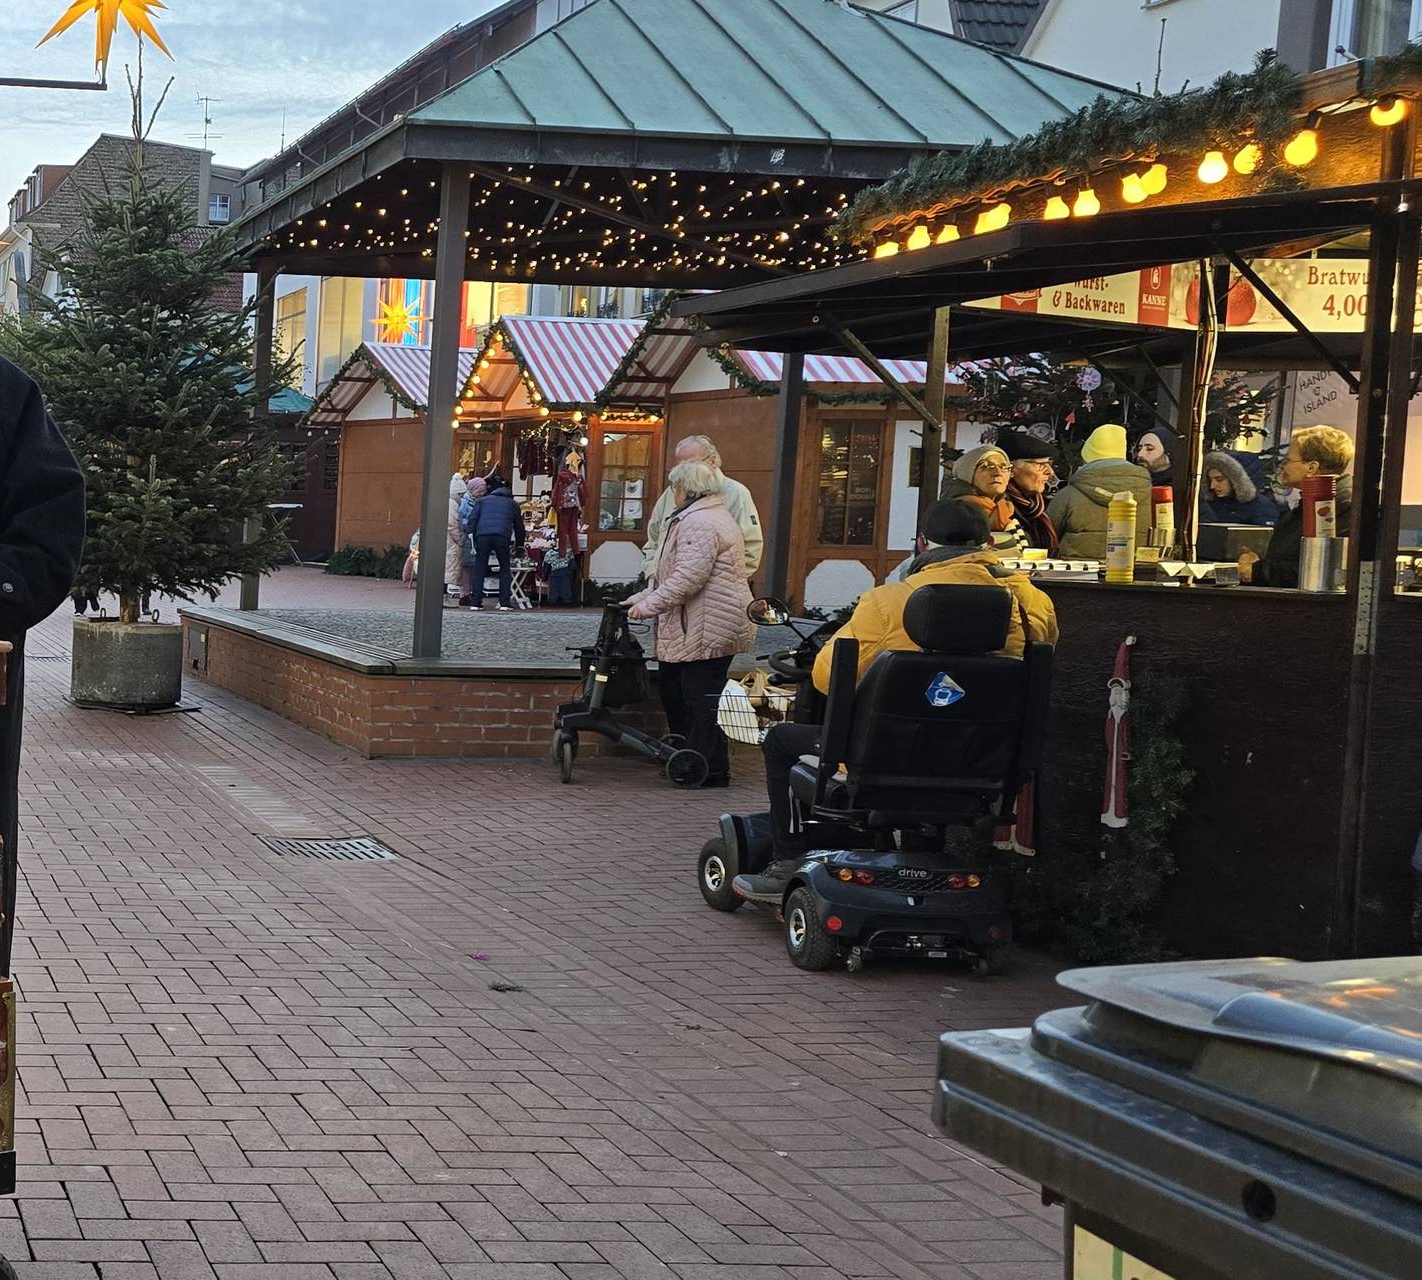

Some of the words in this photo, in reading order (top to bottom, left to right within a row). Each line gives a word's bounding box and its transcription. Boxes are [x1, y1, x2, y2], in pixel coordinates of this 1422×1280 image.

[1307, 265, 1368, 286] Bratwu
[1053, 290, 1062, 308] &
[1065, 291, 1125, 315] Backwaren
[1142, 293, 1167, 307] KANNE
[1299, 370, 1332, 391] HAND
[1303, 390, 1337, 414] ISLAND
[898, 868, 927, 878] drive
